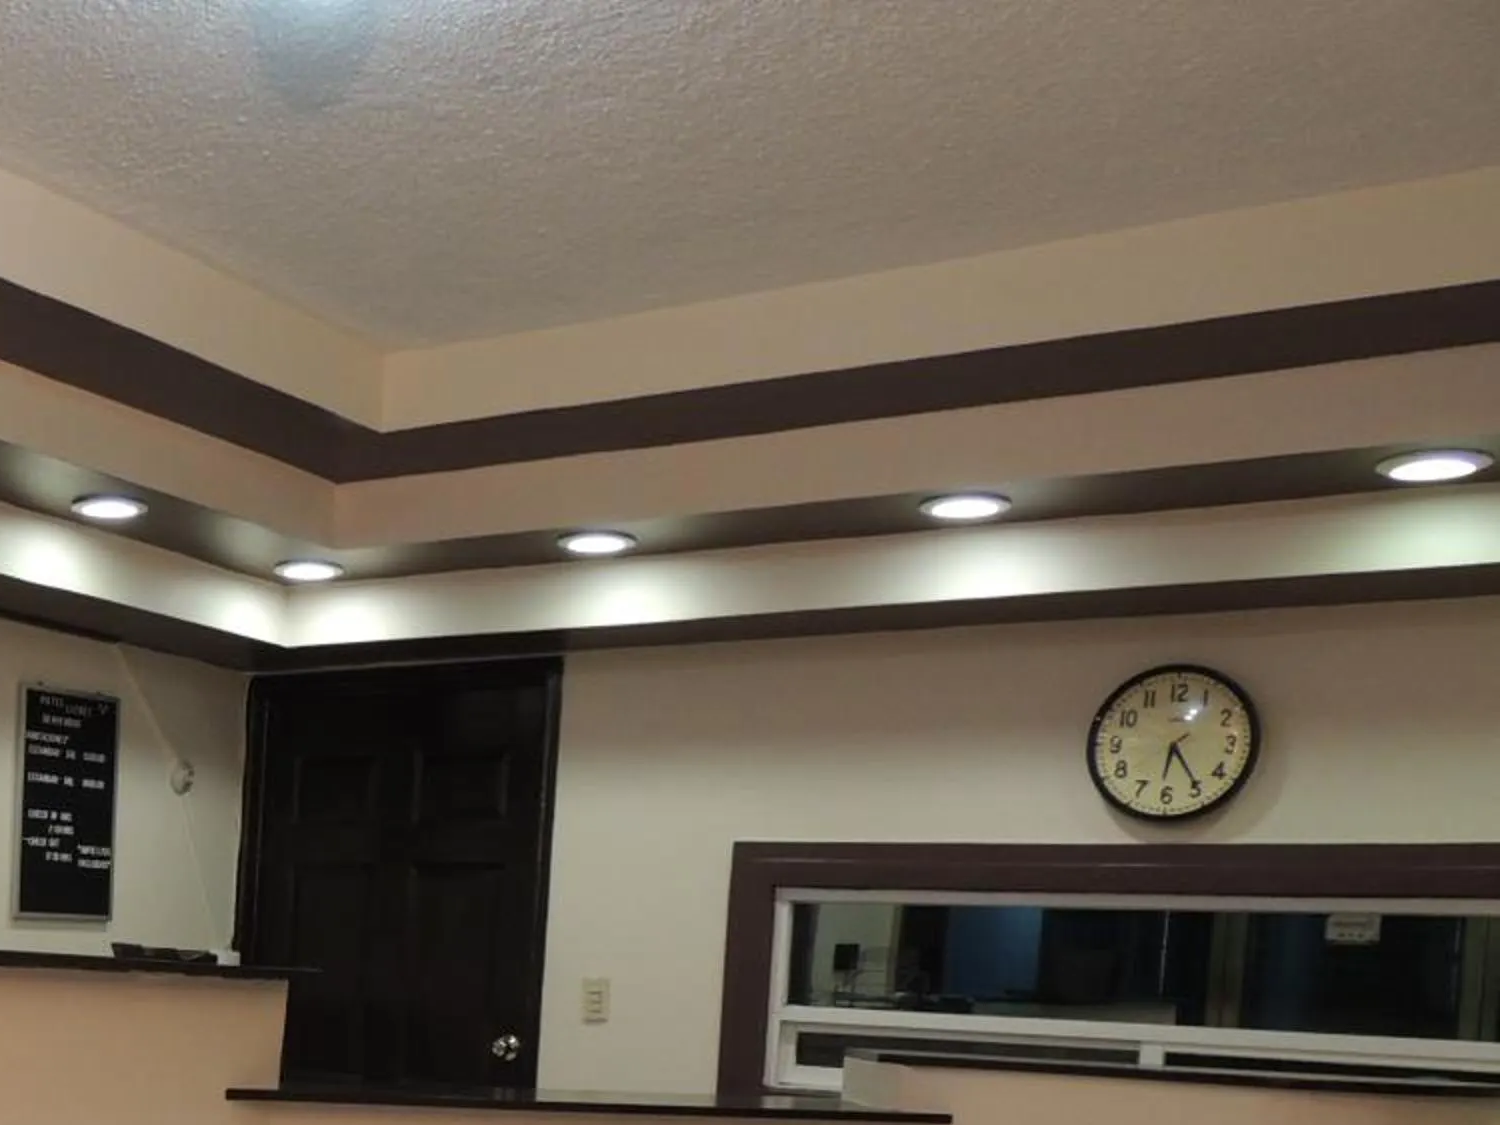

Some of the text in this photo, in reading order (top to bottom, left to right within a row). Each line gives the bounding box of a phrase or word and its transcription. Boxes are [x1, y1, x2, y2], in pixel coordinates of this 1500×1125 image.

[1143, 690, 1156, 708] 11
[1171, 684, 1189, 702] 12
[1120, 709, 1137, 728] 10
[1220, 709, 1232, 727] 2
[1110, 736, 1122, 754] 9
[1225, 735, 1236, 755] 3
[1115, 761, 1128, 778] 8
[1211, 761, 1226, 779] 4
[1135, 780, 1148, 798] 7
[1160, 786, 1172, 804] 6
[1189, 781, 1202, 798] 5
